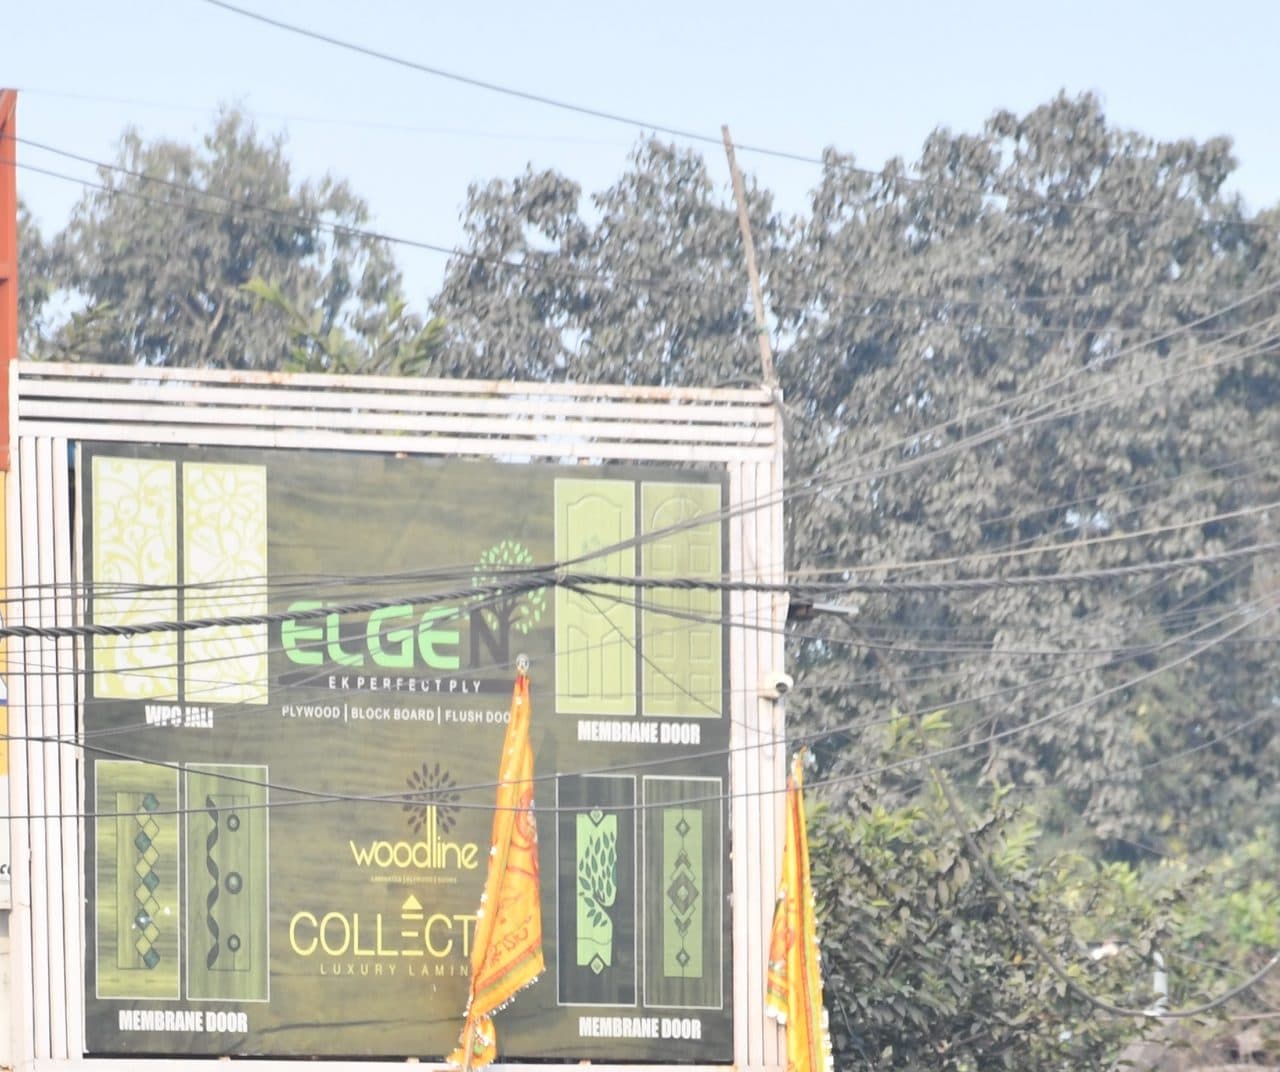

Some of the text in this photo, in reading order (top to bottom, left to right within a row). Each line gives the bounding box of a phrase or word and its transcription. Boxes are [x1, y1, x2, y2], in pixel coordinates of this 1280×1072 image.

[281, 600, 511, 671] ELGEN
[328, 675, 482, 693] EK PERFECT PLY
[282, 706, 512, 723] PLYWOOD BLOCK BOARD FLUSH DOO
[578, 720, 701, 745] MEMBRANE DOOR
[350, 805, 479, 870] woodline
[320, 963, 470, 977] LUXURY LAMIN
[118, 1010, 248, 1033] MEMBRANE DOOR
[579, 1016, 702, 1040] MEMBRANE DOOR
